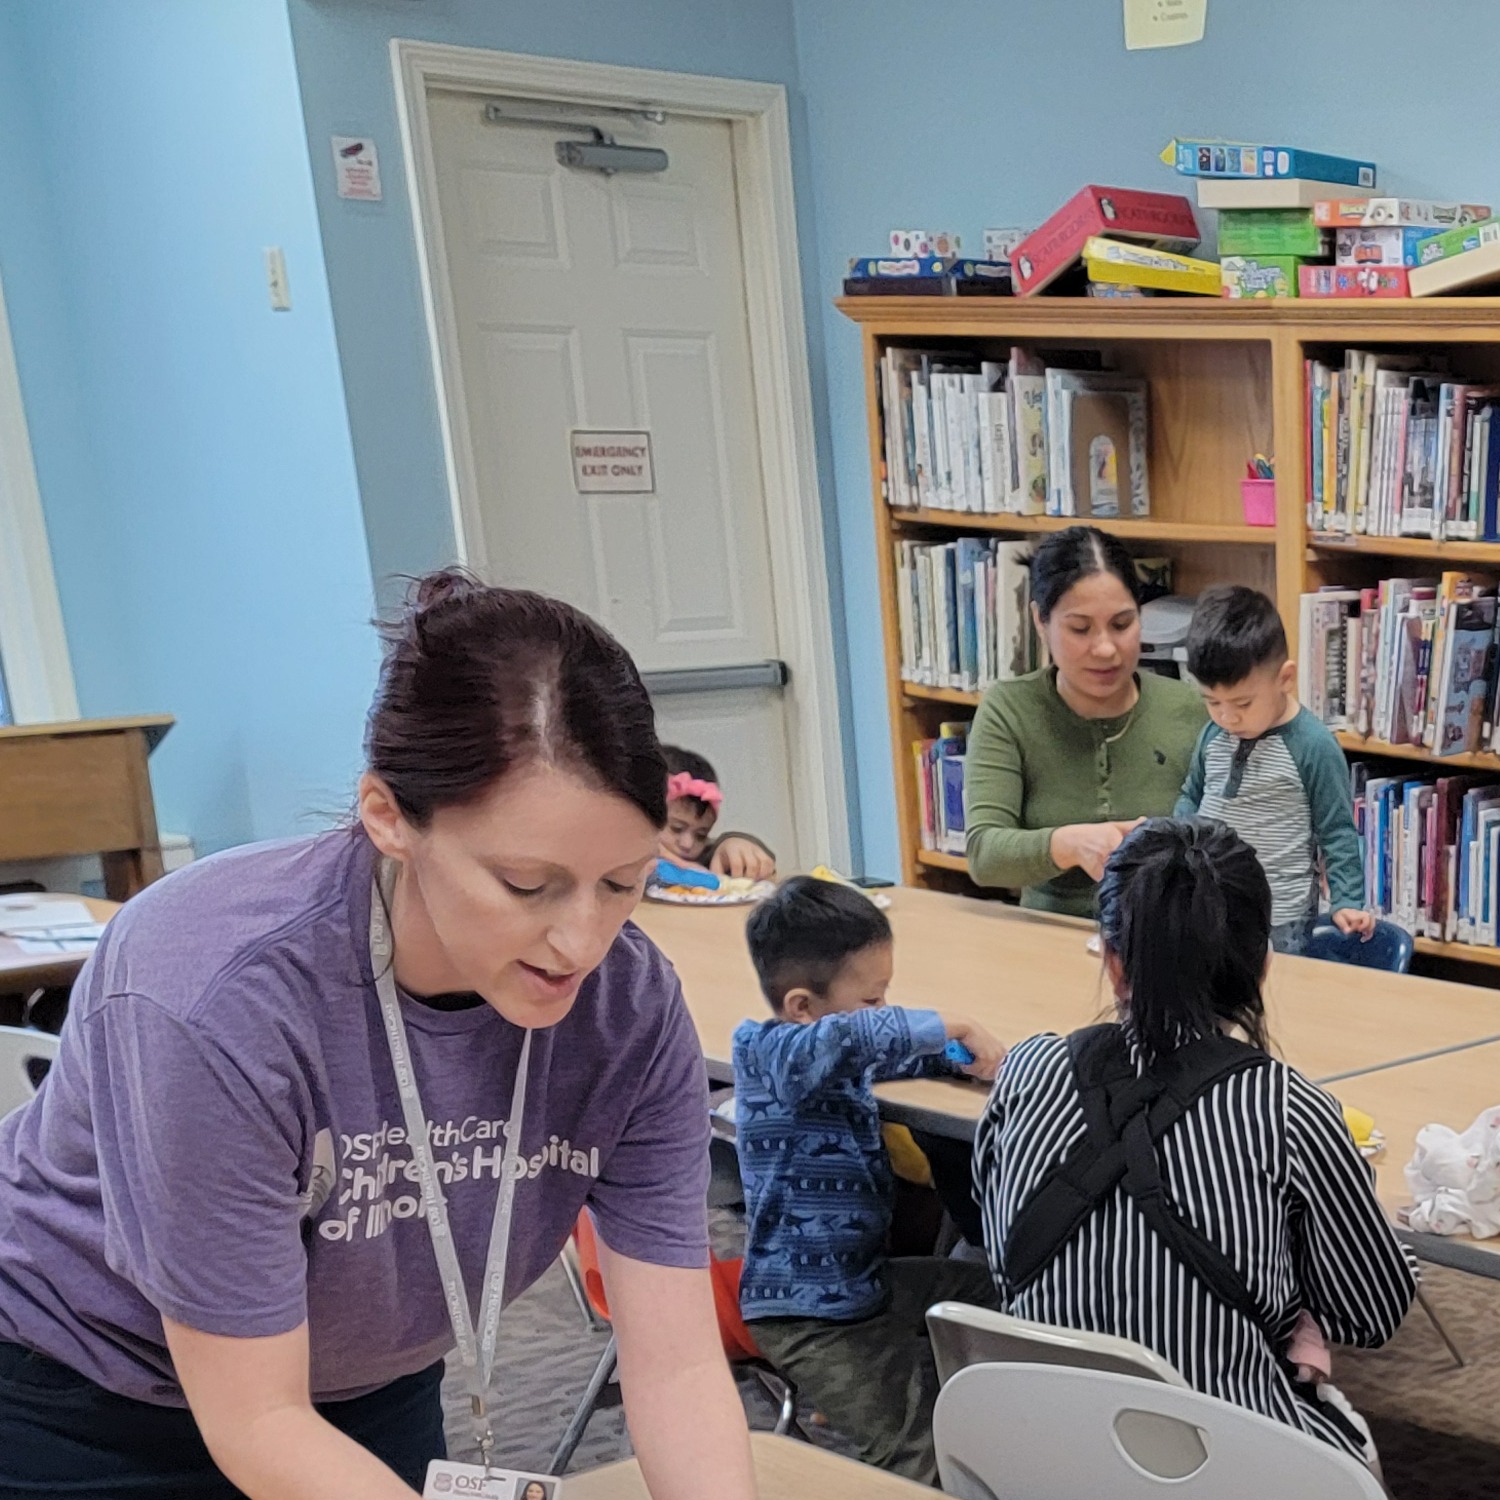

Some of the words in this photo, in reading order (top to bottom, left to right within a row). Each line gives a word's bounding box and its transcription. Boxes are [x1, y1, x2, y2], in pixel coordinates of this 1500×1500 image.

[575, 445, 647, 458] EMERGENCY
[582, 464, 608, 477] EXIT
[611, 464, 643, 477] ONLY
[318, 1206, 361, 1242] of
[455, 1474, 487, 1492] OSF
